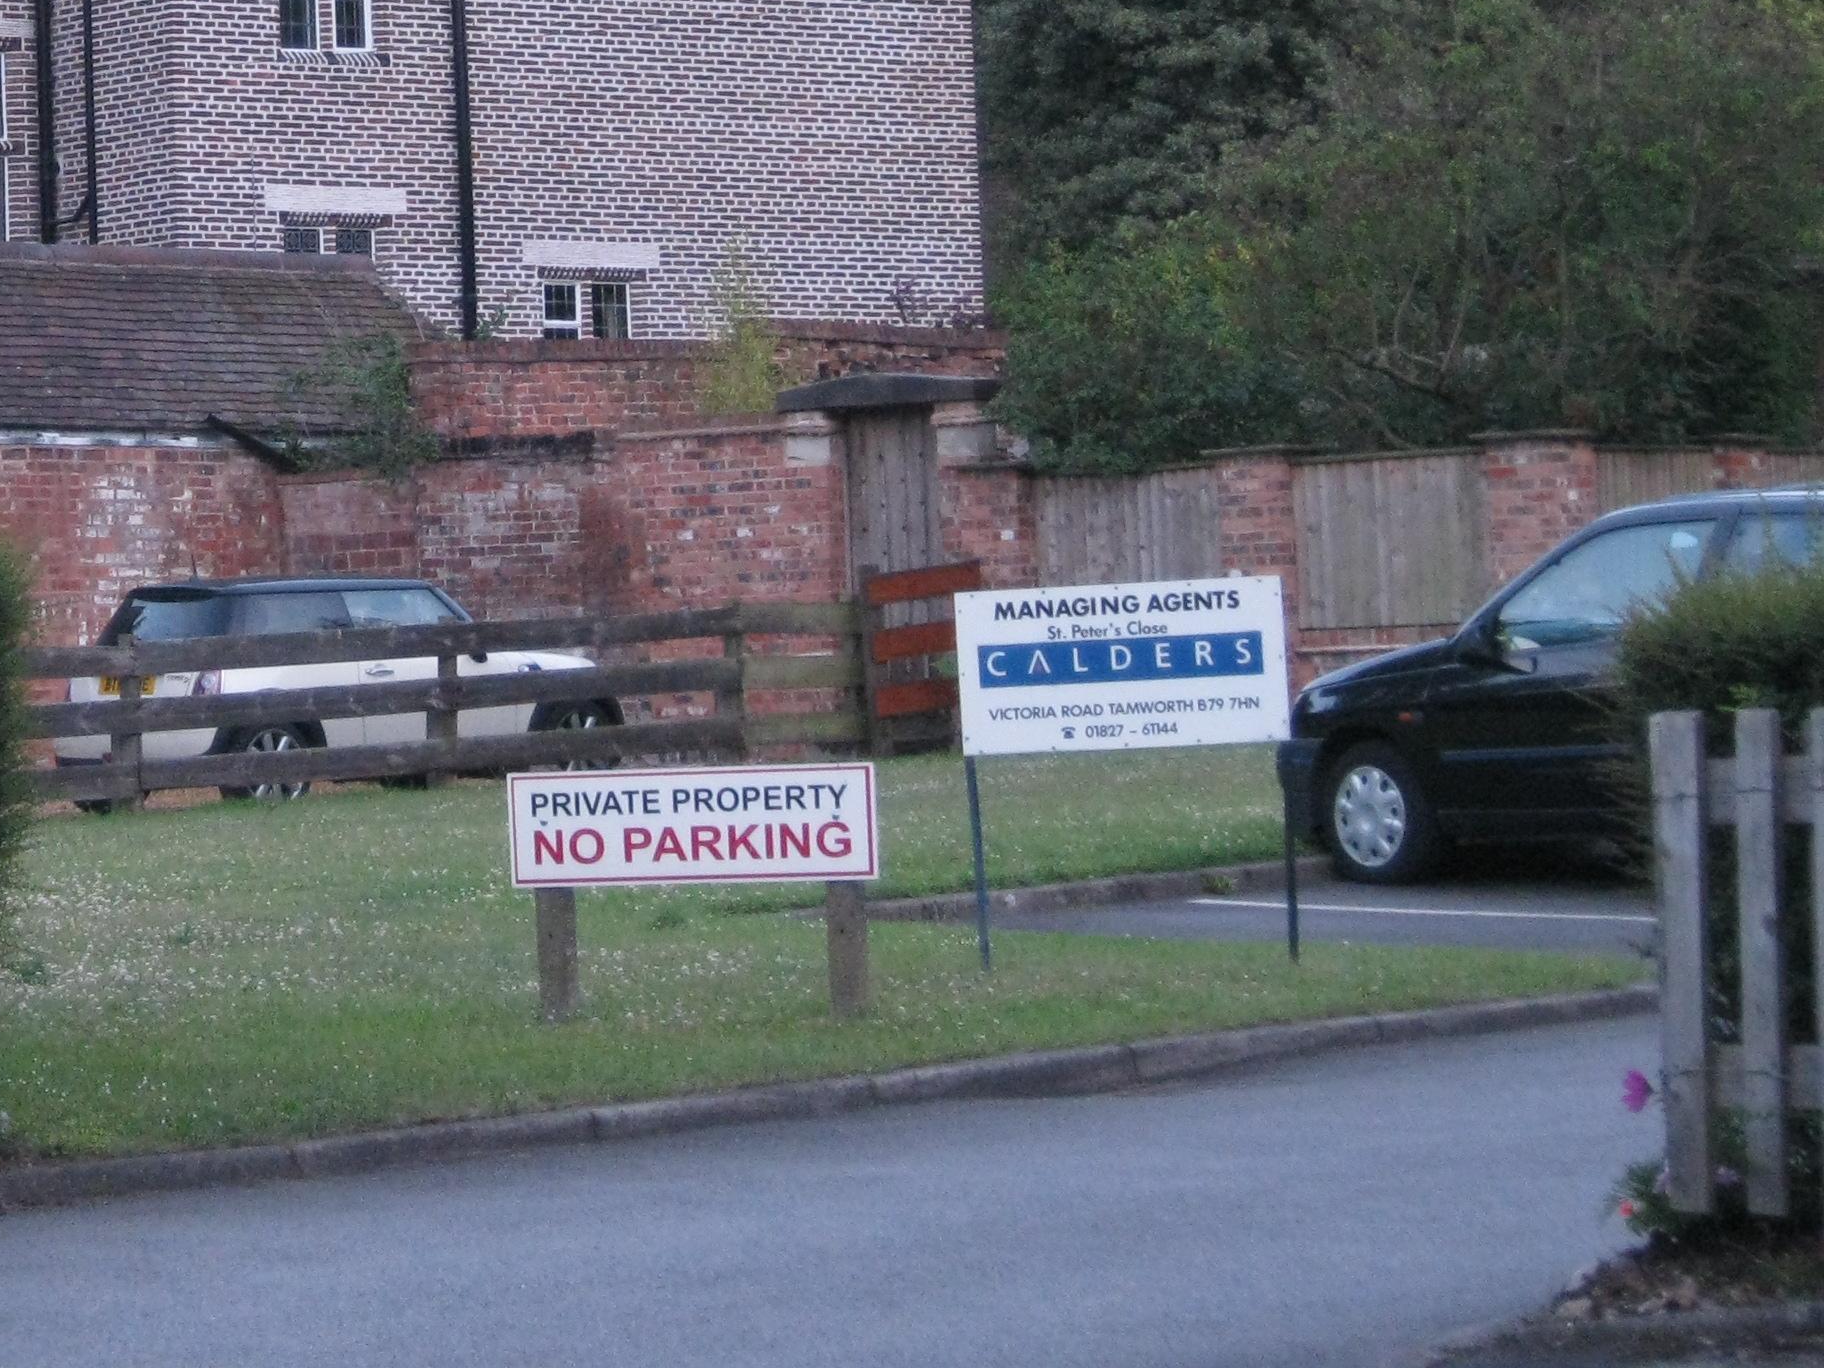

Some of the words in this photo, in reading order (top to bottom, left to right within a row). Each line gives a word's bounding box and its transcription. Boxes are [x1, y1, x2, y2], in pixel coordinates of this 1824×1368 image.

[994, 595, 1140, 621] MANAGING
[1146, 590, 1240, 613] AGENTS
[1047, 625, 1067, 640] St.
[1071, 623, 1122, 639] Peter's
[1126, 620, 1168, 635] Close
[986, 638, 1252, 676] CALDERS
[989, 706, 1056, 720] VICTORIA
[1061, 703, 1104, 718] ROAD
[1108, 699, 1194, 716] TAMWORTH
[1197, 698, 1224, 712] B79
[1229, 696, 1260, 710] 7HN
[1085, 724, 1124, 738] 01827
[1142, 720, 1178, 736] 61144
[531, 789, 661, 818] PRIVATE
[672, 784, 847, 813] PROPERTY
[533, 828, 605, 866] NO
[623, 820, 852, 864] PARKING
